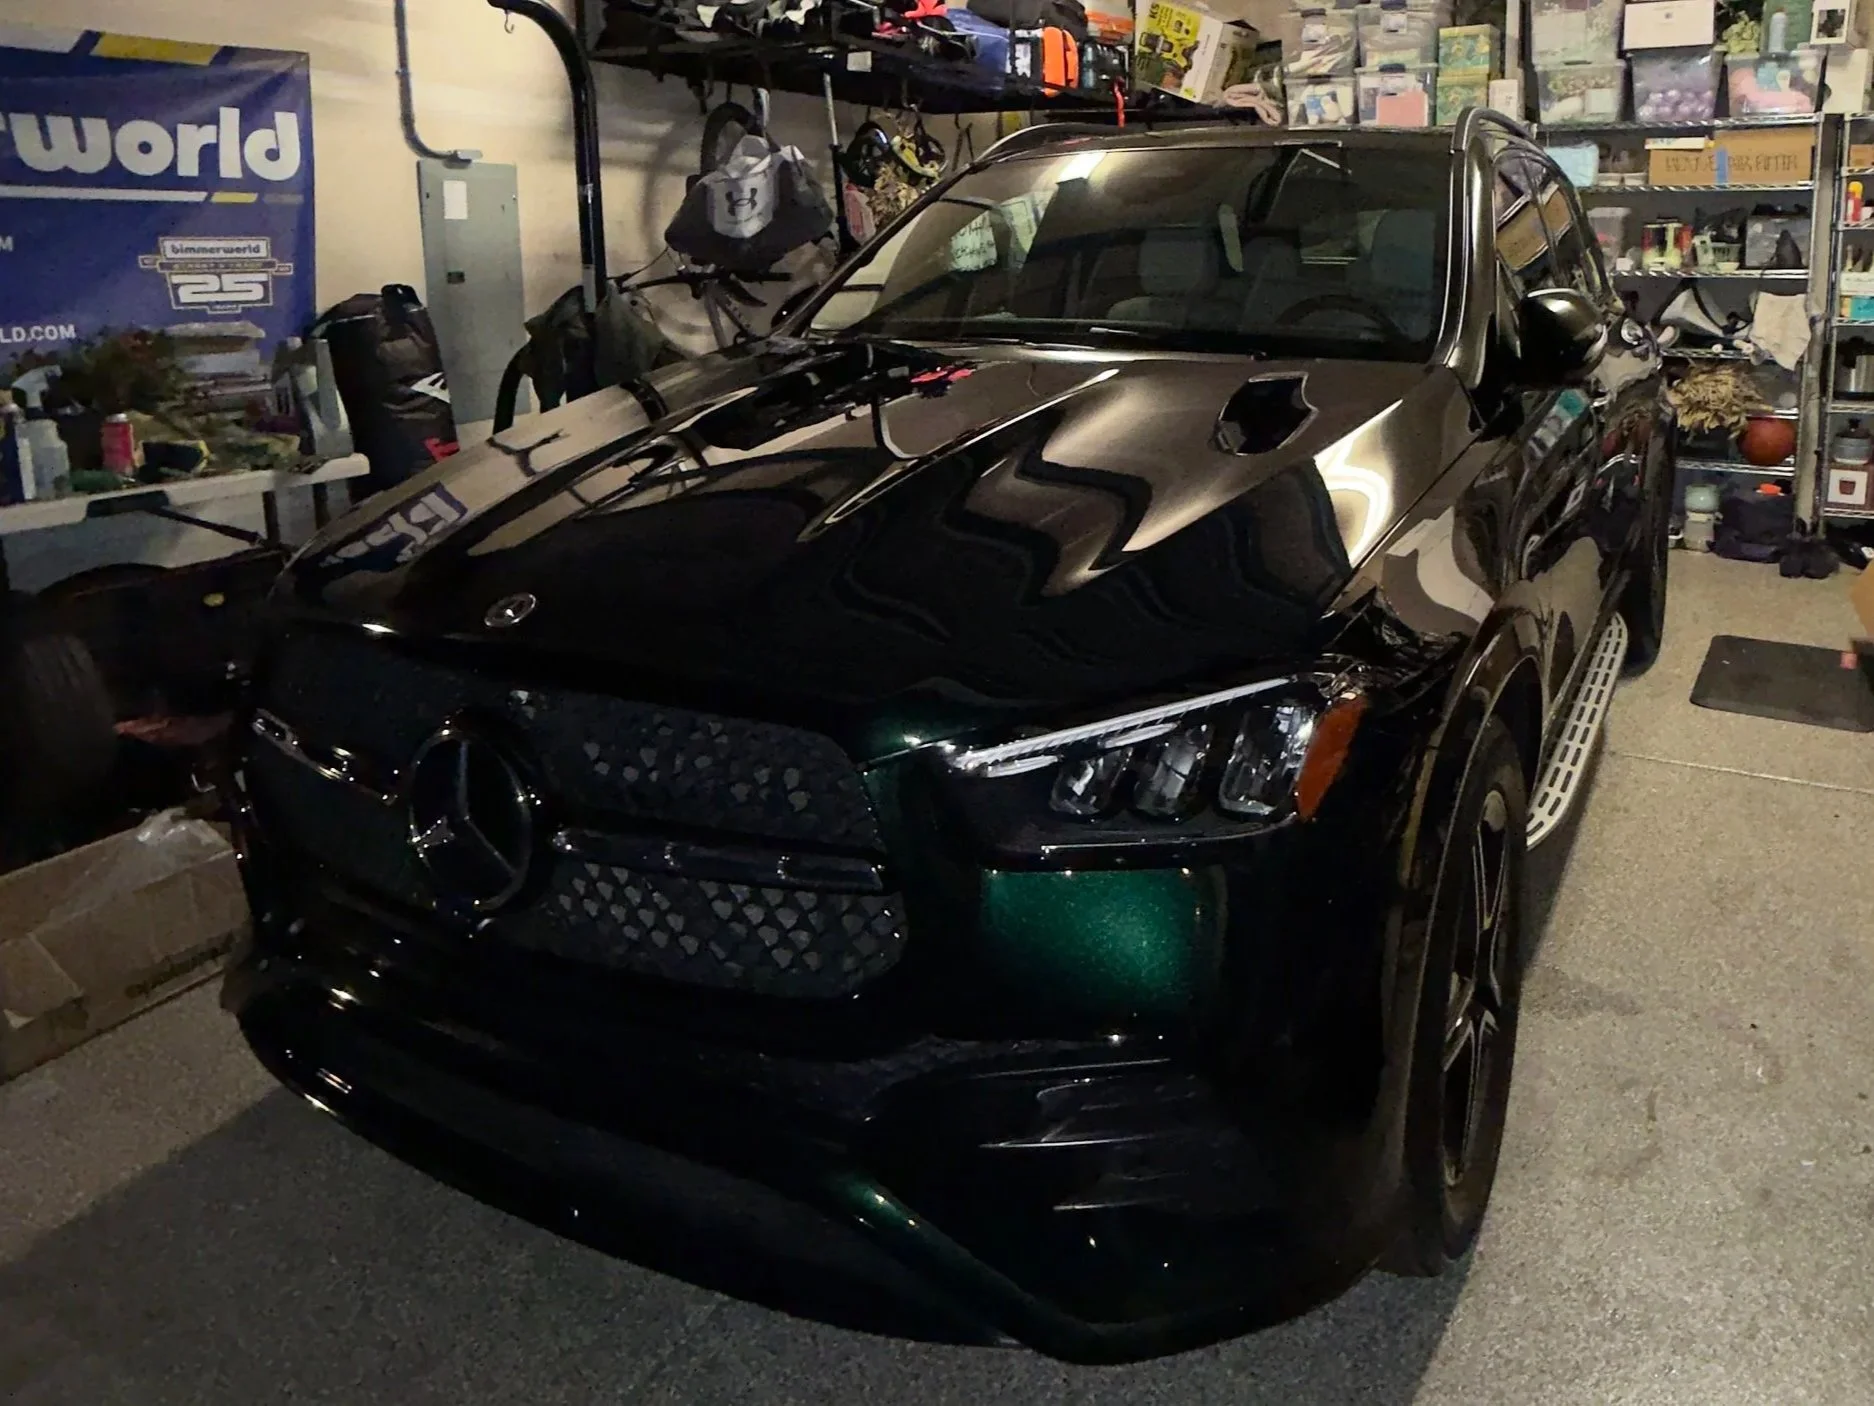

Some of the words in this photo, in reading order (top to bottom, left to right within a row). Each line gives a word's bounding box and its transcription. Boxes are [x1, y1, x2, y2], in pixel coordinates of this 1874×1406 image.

[171, 243, 261, 254] bimmerworld
[171, 273, 268, 304] 25
[0, 323, 77, 344] LD.COM
